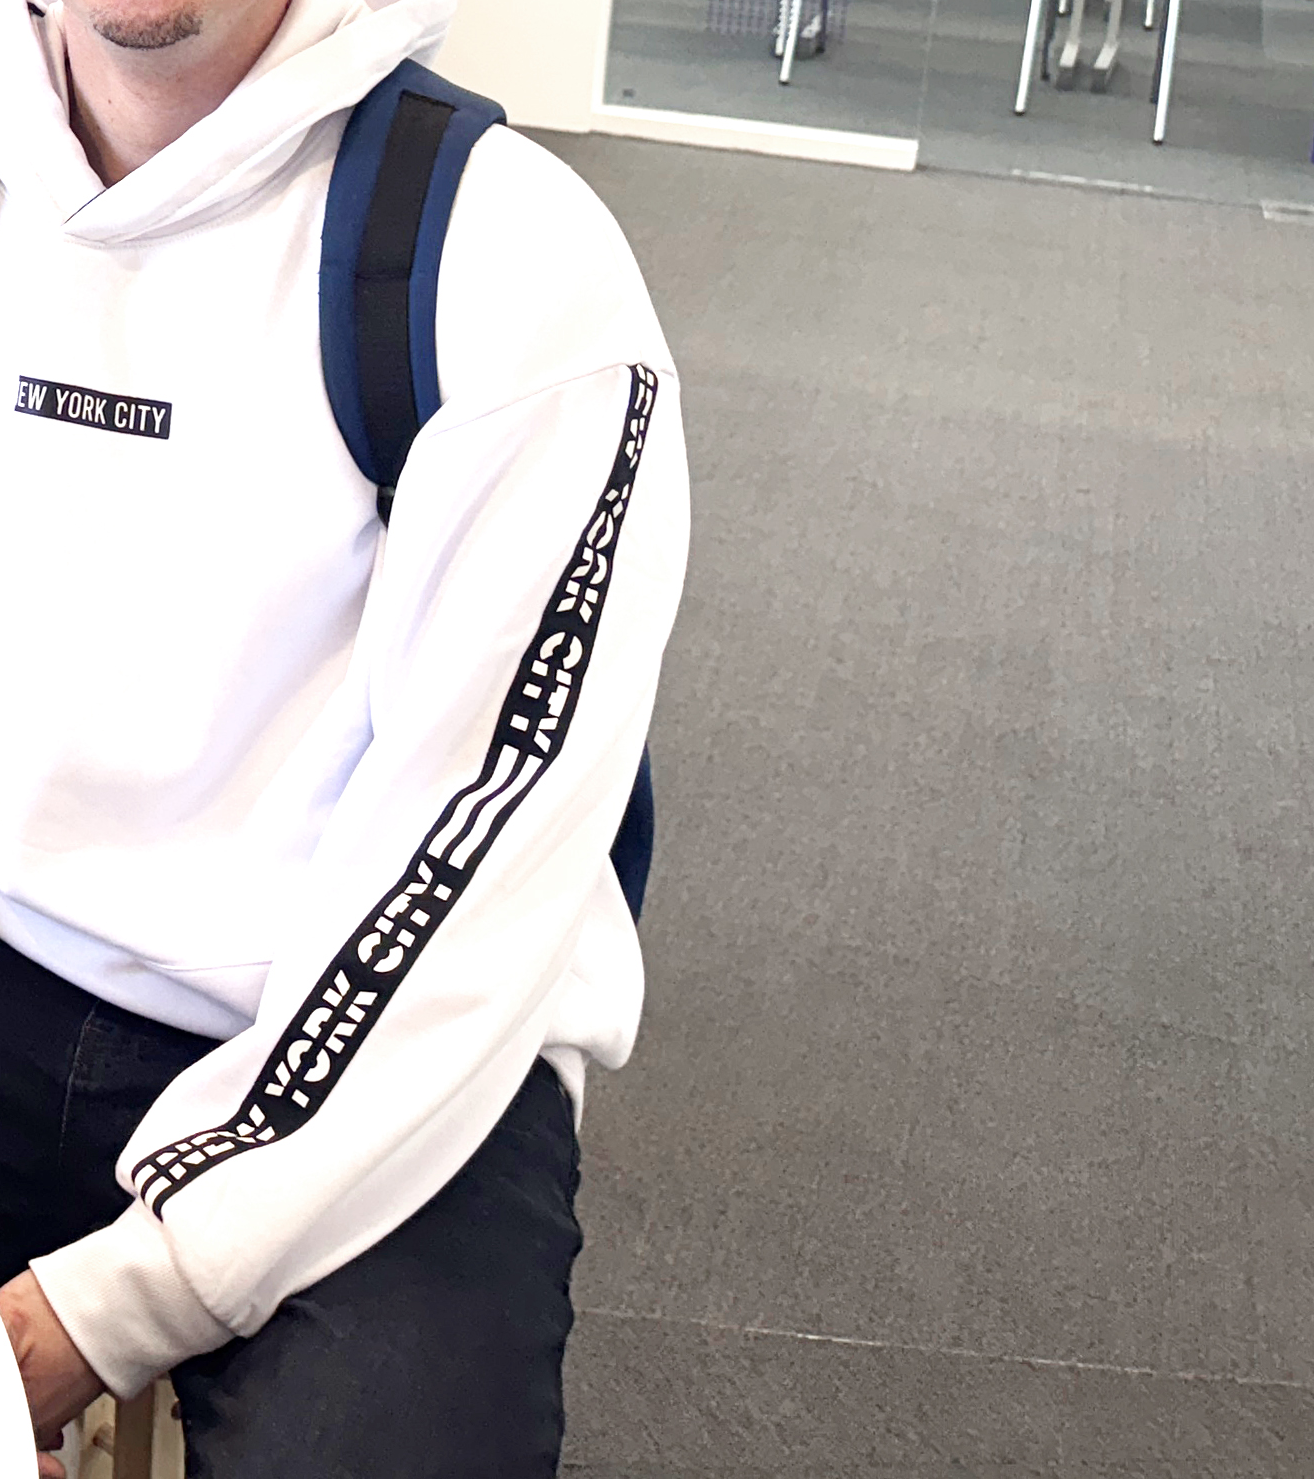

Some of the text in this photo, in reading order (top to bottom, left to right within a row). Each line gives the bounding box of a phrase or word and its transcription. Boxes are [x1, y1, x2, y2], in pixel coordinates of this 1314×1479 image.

[55, 388, 106, 425] YORK
[114, 401, 166, 434] CITY
[510, 630, 586, 755] CITY
[156, 859, 453, 1180] NEW YORK CITY
